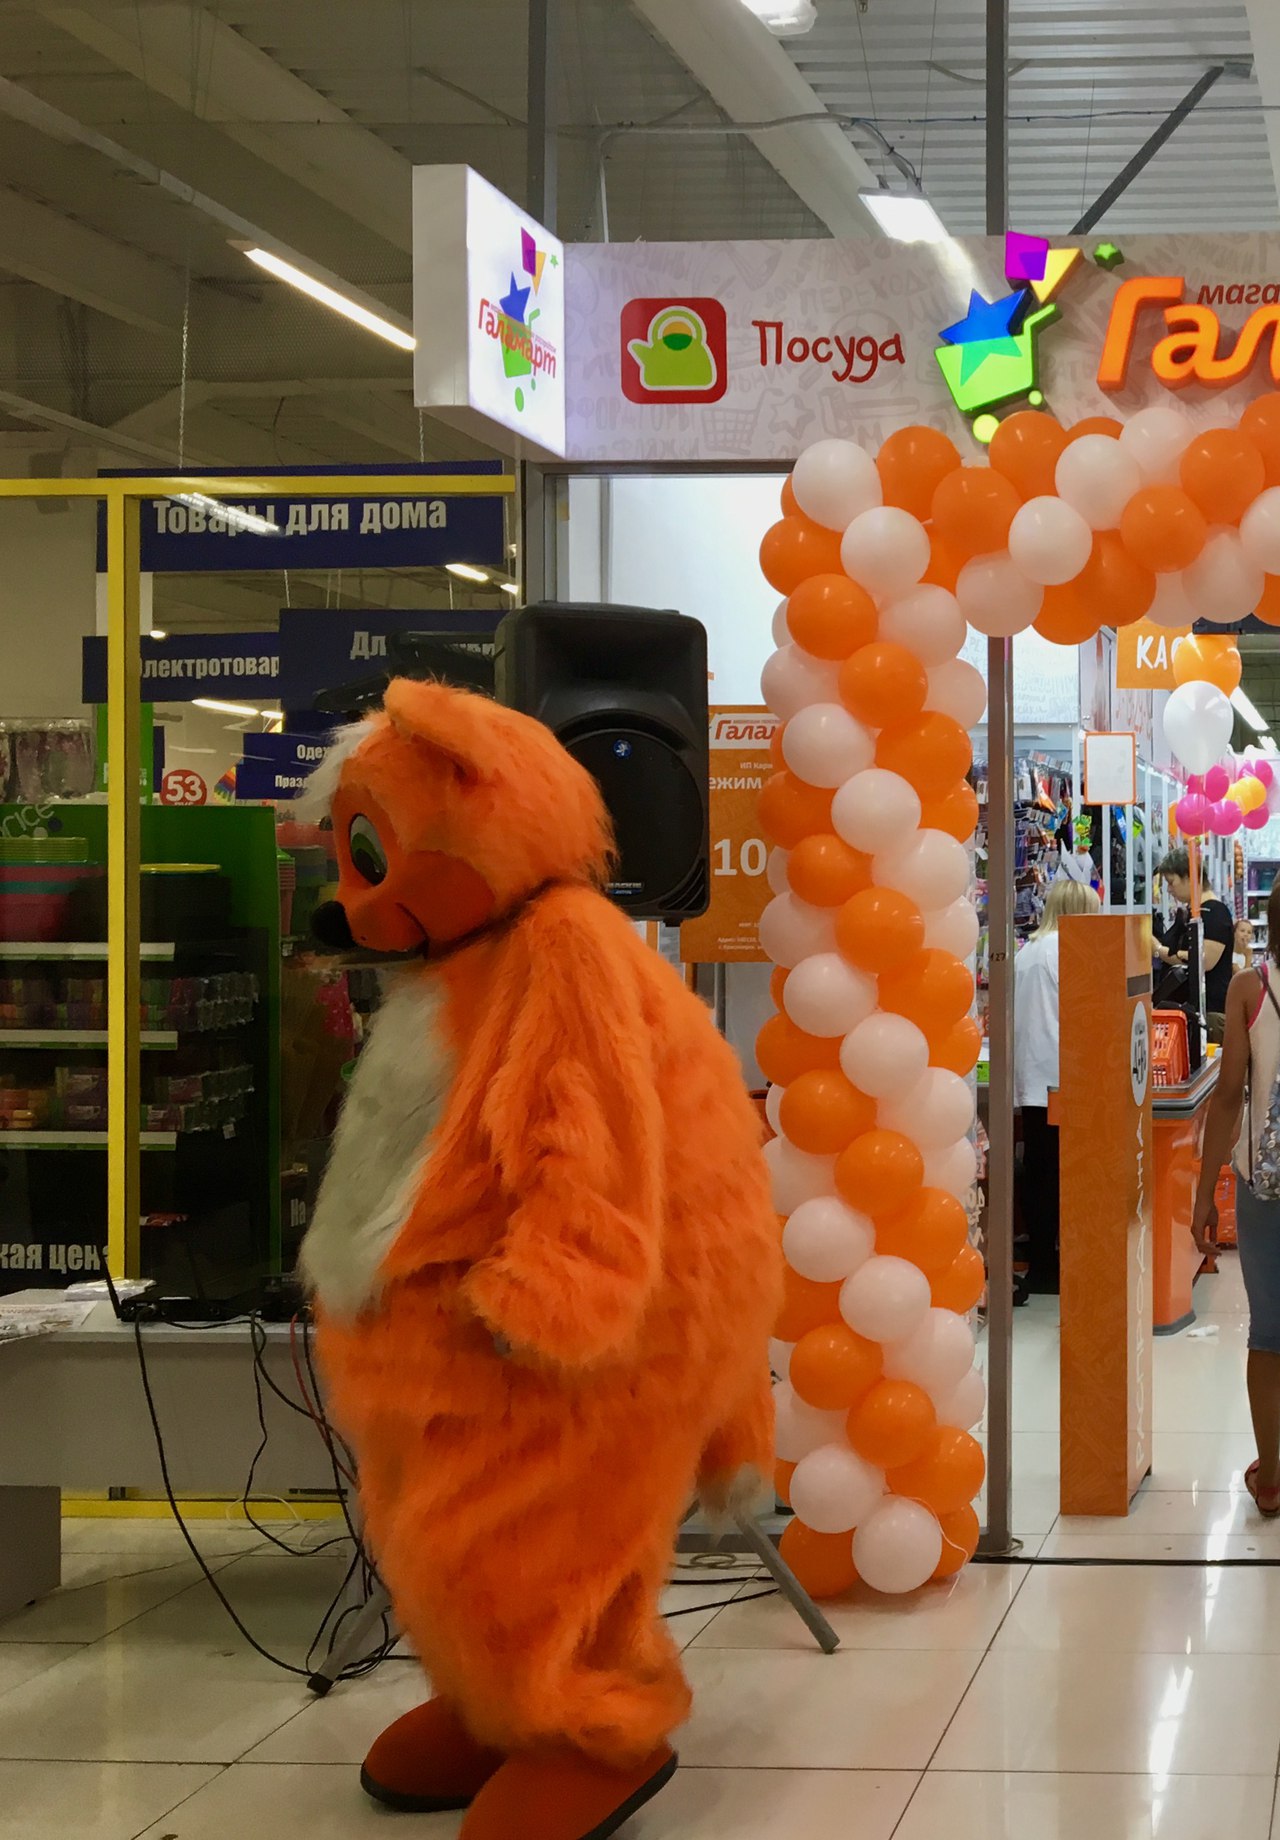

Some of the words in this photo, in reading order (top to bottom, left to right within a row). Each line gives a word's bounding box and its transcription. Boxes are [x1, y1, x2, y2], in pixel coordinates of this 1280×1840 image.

[478, 297, 557, 380] Галамарт
[751, 319, 906, 384] Посуда
[285, 501, 350, 536] для
[359, 500, 447, 535] дома
[350, 631, 388, 661] Дл
[139, 655, 280, 680] лектротовар
[166, 774, 204, 803] 53
[708, 776, 763, 792] ежим
[713, 837, 768, 878] 10
[49, 1243, 108, 1275] цен
